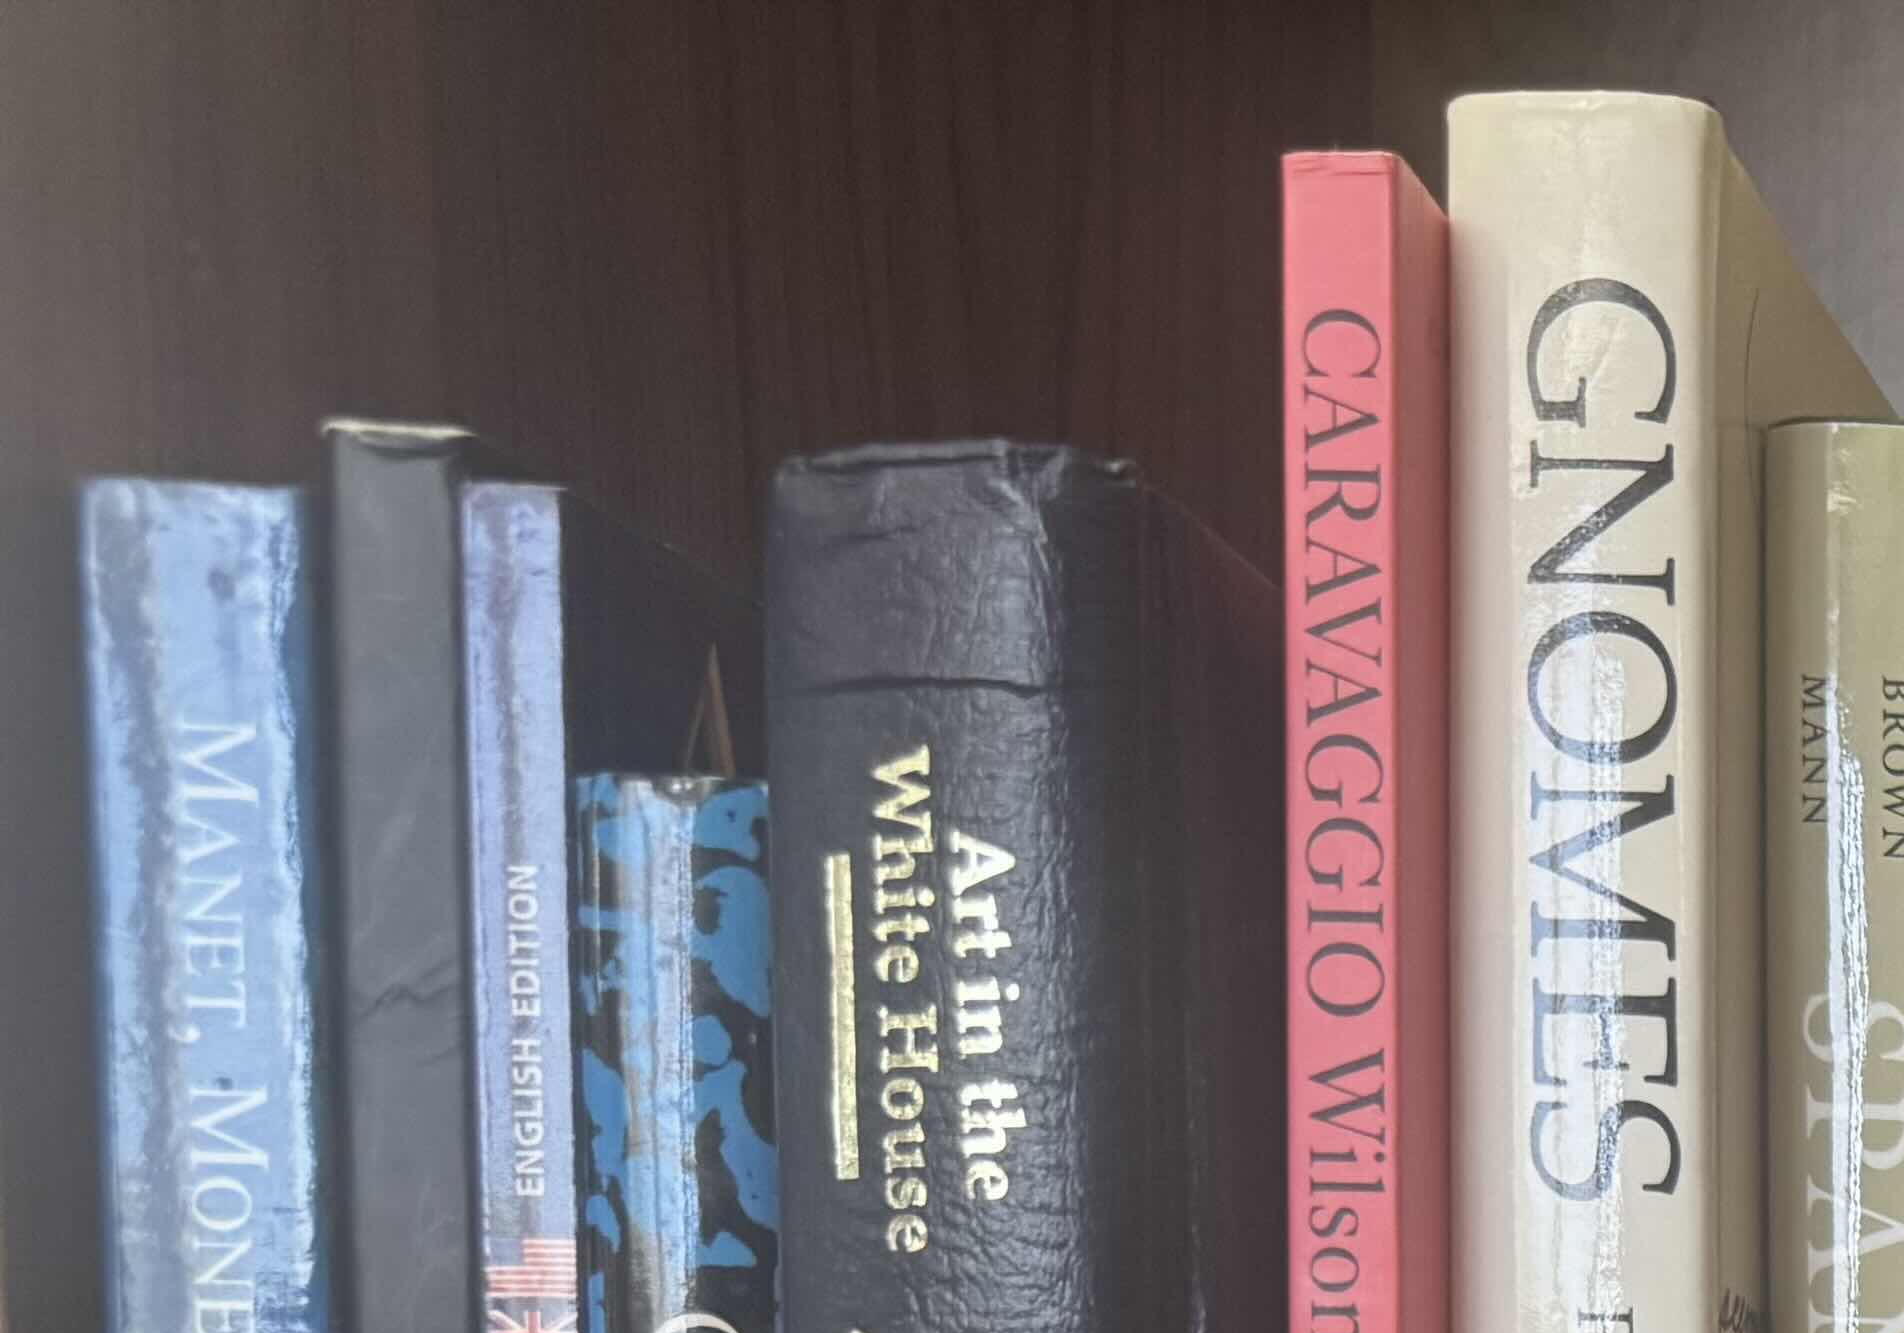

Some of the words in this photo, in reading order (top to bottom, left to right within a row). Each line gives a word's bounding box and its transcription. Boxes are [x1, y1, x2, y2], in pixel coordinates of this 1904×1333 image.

[1301, 307, 1388, 1019] CARAVAGGIO
[1526, 277, 1682, 1204] GNOMES
[1802, 674, 1829, 826] MANN
[174, 719, 259, 1044] MANET,
[506, 865, 541, 1020] EDITION
[871, 743, 936, 985] White
[948, 829, 1018, 961] Art
[957, 982, 1021, 1061] in
[514, 1036, 544, 1198] ENGLISH
[876, 1006, 940, 1256] House
[957, 1074, 1031, 1203] the
